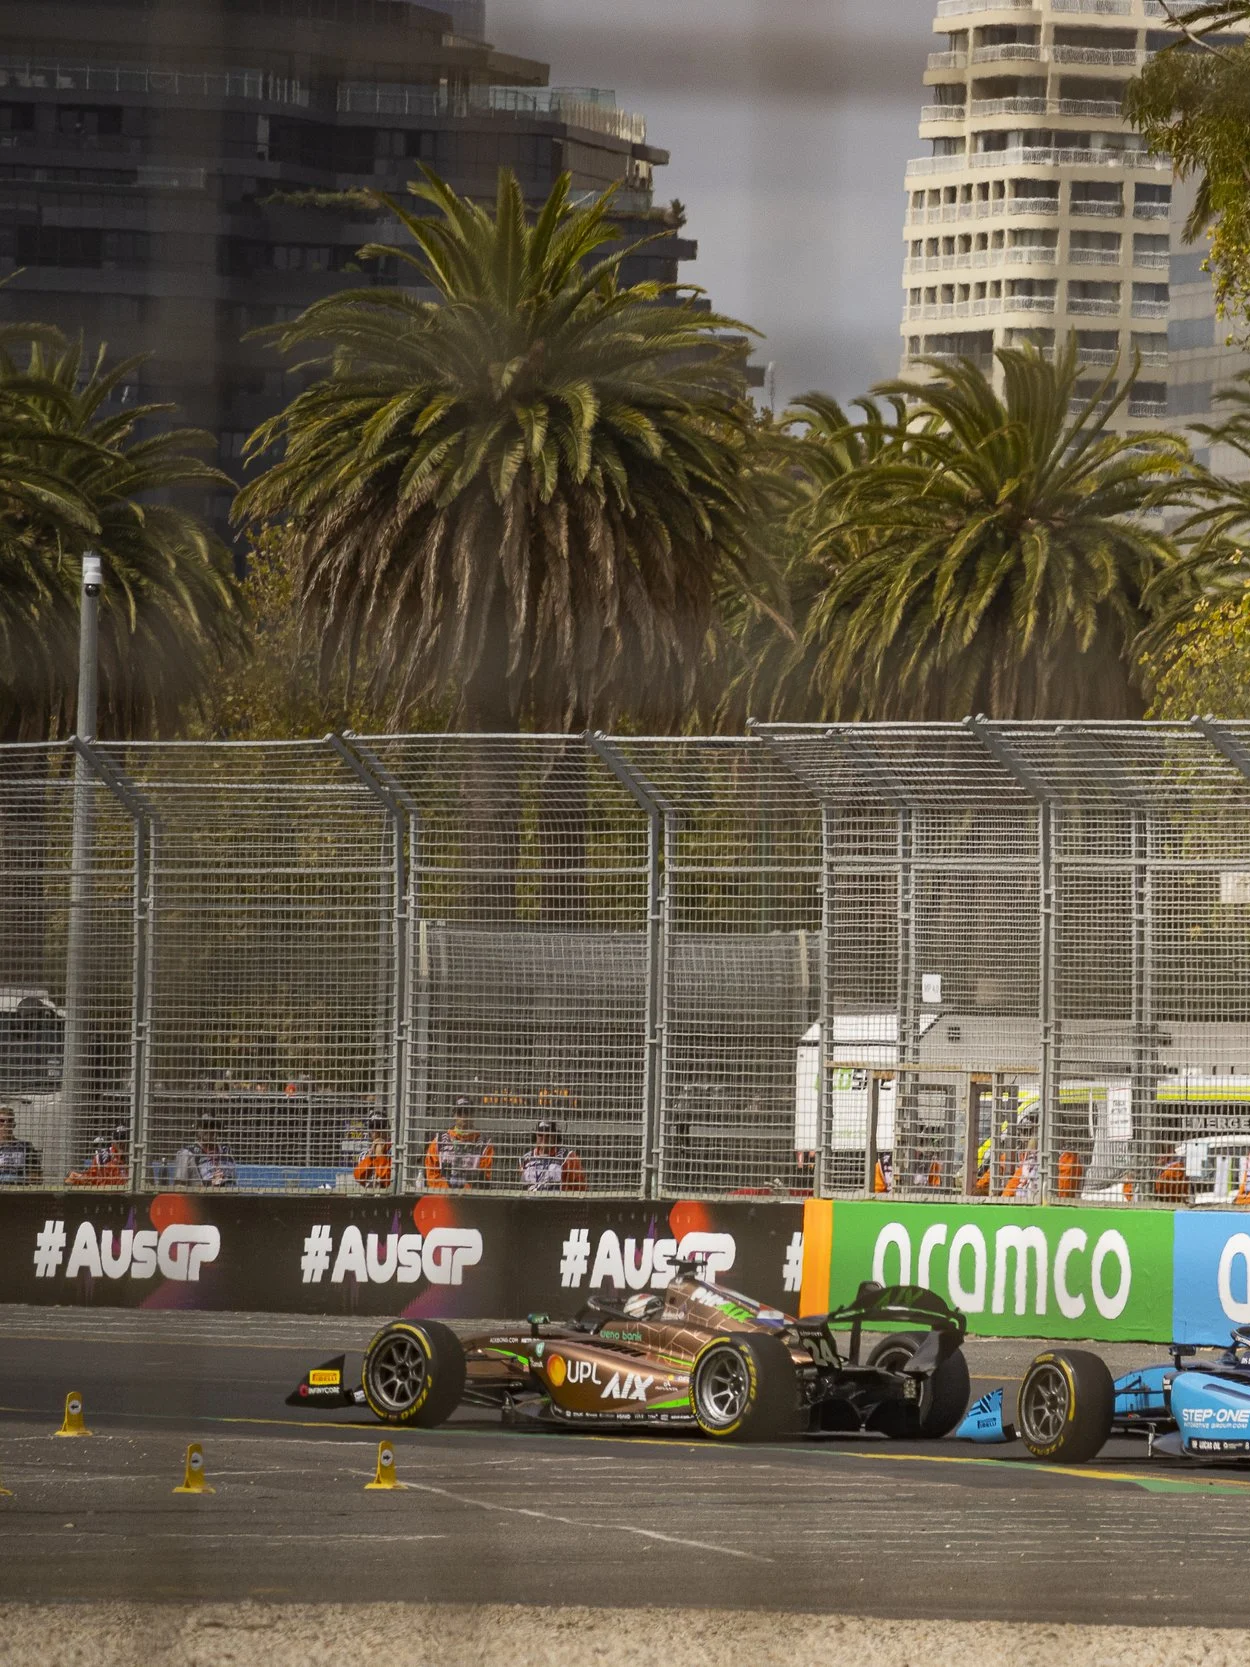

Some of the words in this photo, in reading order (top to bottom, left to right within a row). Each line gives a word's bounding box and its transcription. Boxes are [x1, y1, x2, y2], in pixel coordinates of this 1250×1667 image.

[872, 1222, 1132, 1319] aramco
[622, 1331, 642, 1341] bank
[803, 1339, 841, 1369] 24
[567, 1361, 602, 1385] UPL
